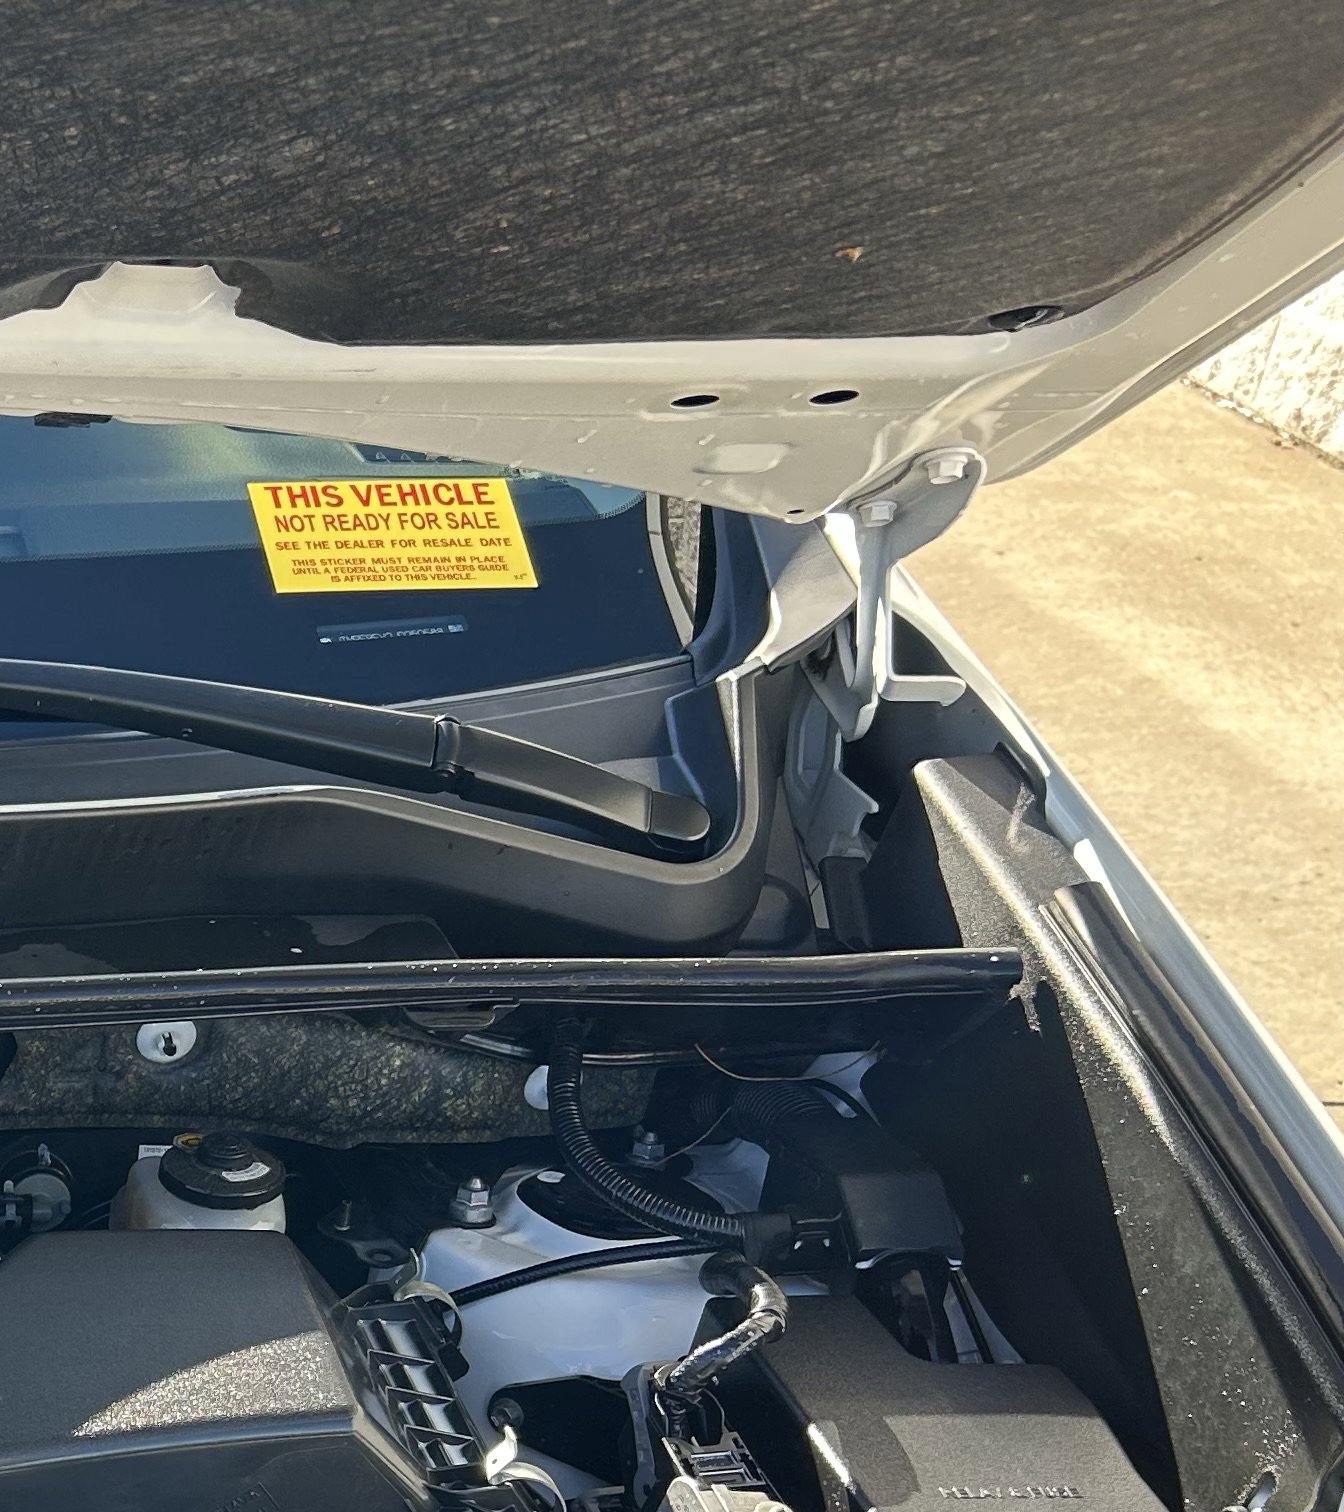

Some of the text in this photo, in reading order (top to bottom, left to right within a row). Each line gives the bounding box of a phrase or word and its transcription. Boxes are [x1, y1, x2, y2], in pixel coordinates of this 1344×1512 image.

[264, 483, 495, 508] THIS VEHICLE
[274, 511, 500, 532] NOT READY FOR SALE
[275, 537, 512, 550] SEE THE DEALER FOR RESALE DATE
[319, 558, 367, 566] STICKER
[371, 557, 402, 565] MUST
[407, 556, 451, 564] REMAIN
[470, 555, 505, 563] PLACE
[291, 567, 321, 575] UNTIL
[334, 566, 380, 574] FEDERAL
[382, 565, 409, 573] USED
[343, 574, 386, 582] AFFIXED
[405, 573, 428, 581] THIS
